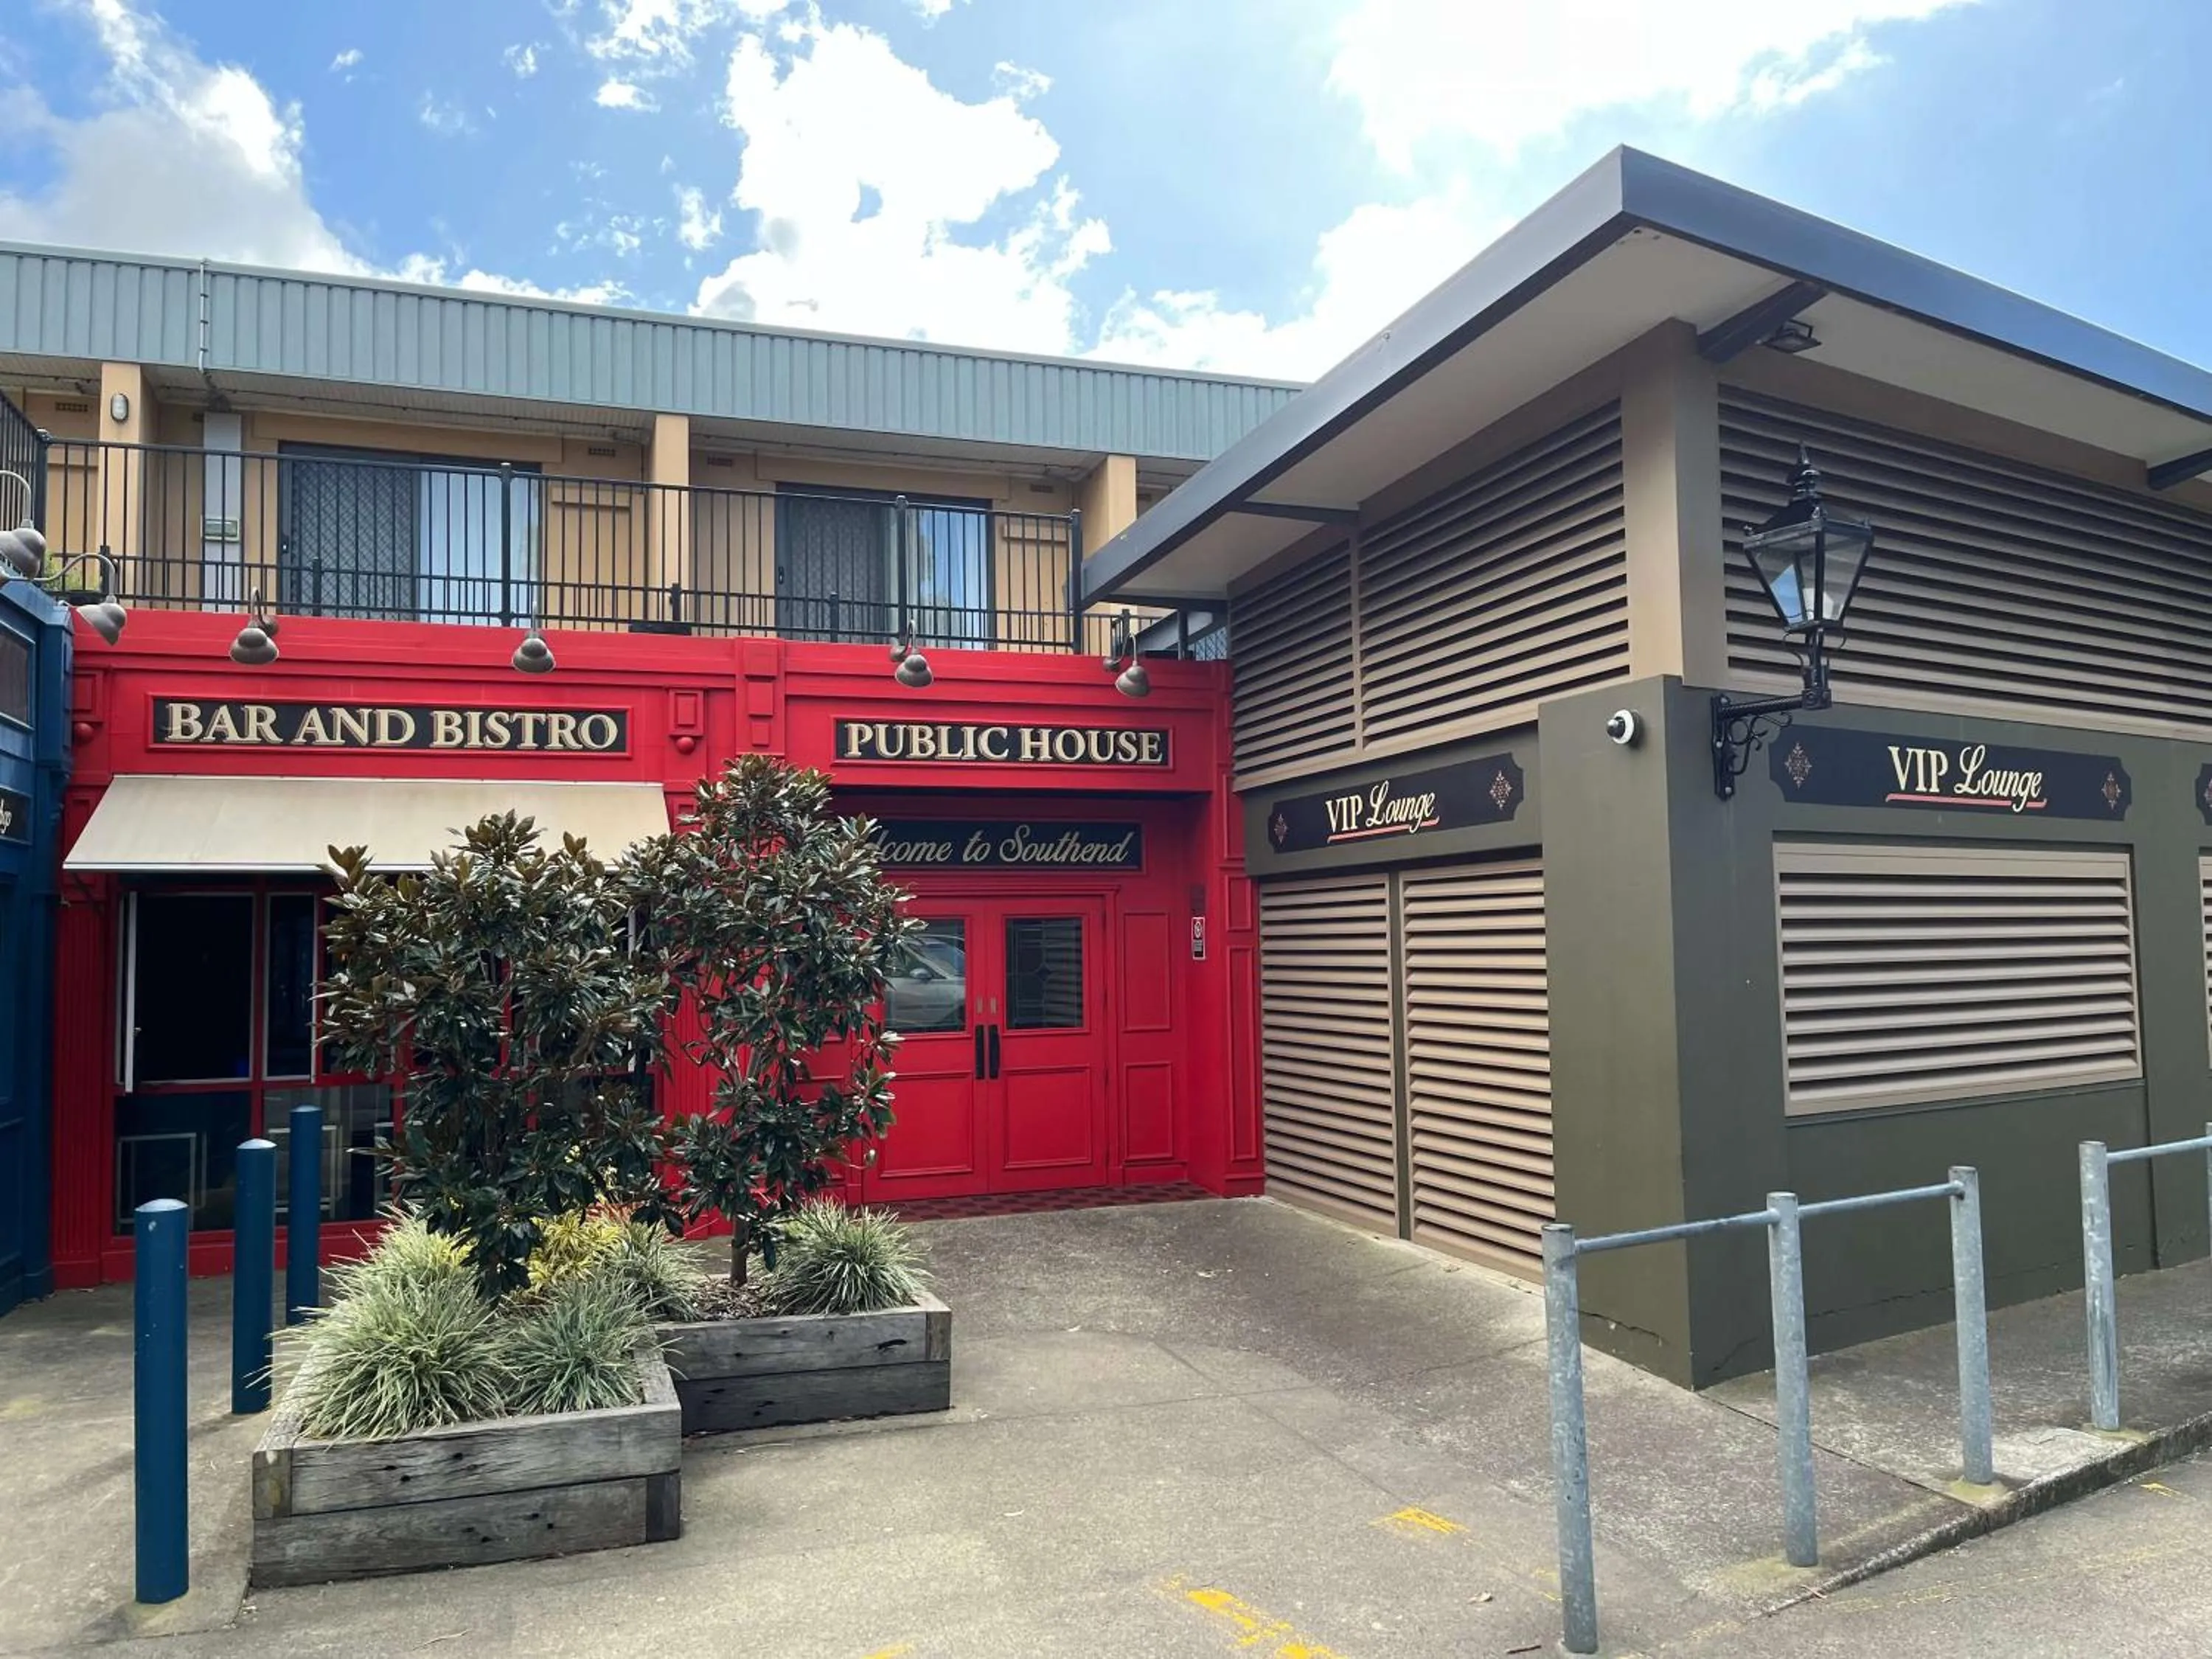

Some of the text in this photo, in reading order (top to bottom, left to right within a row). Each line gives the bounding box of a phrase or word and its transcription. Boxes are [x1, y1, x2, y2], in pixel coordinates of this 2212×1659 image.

[165, 702, 619, 751] BAR AND BISTRO
[845, 723, 1163, 764] PUBLIC HOUSE
[1888, 744, 2043, 813] VIP Lounge
[1325, 779, 1436, 834] VIP Lounge
[877, 824, 1135, 863] lcome to Southend
